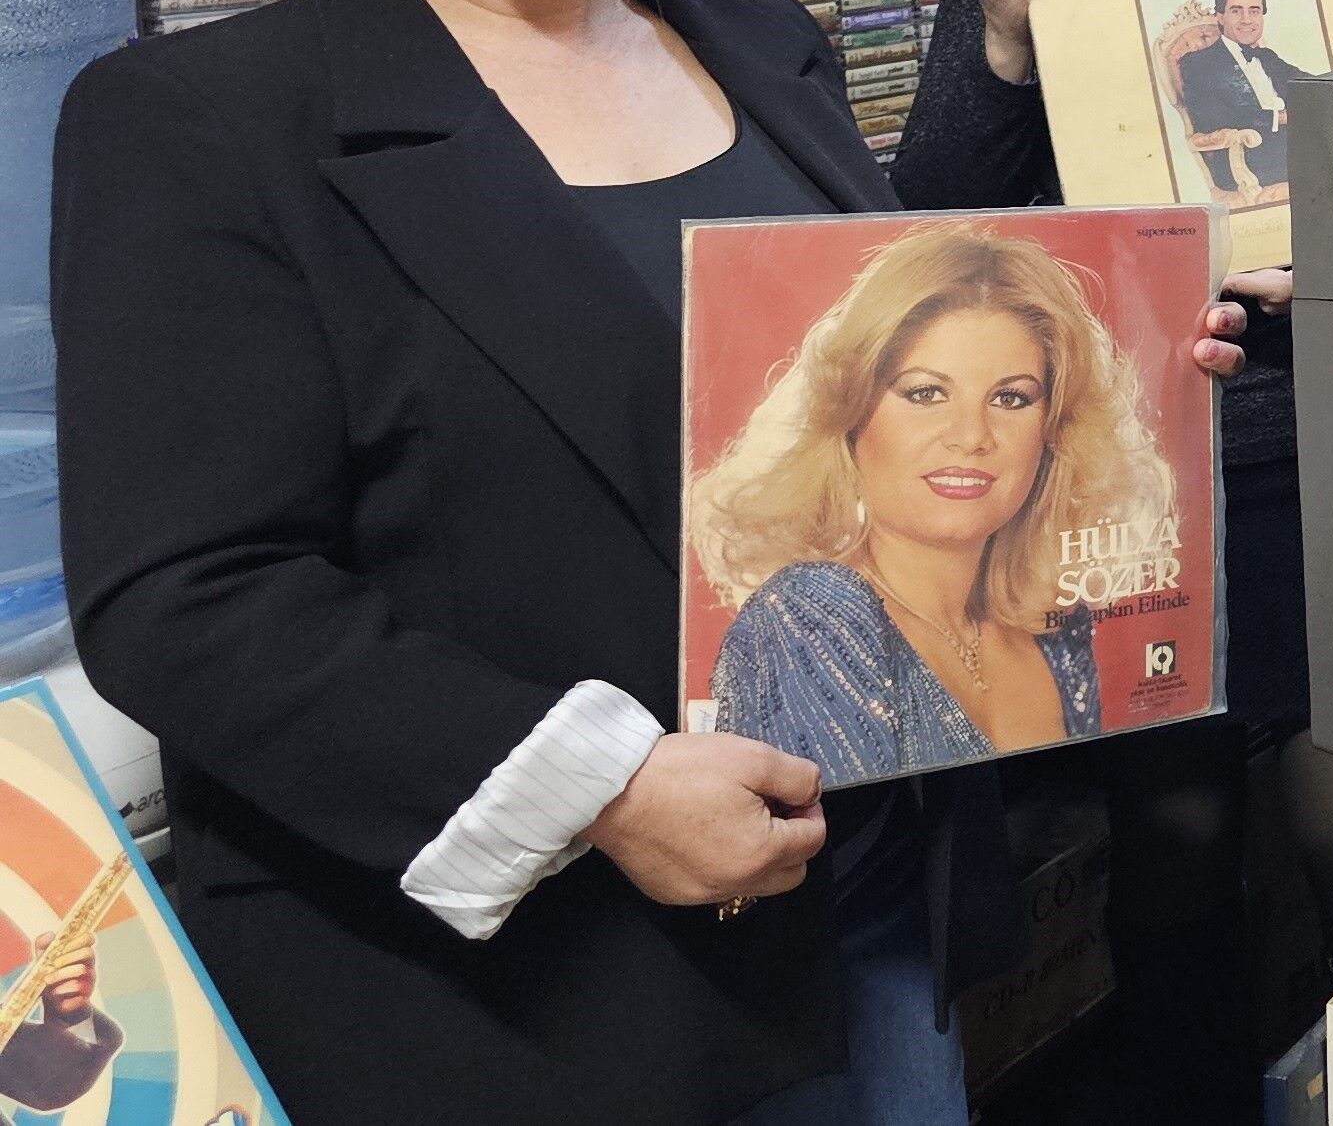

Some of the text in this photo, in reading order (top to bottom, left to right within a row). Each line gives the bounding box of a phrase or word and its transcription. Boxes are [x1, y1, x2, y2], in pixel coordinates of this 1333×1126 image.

[1059, 517, 1182, 566] HÜLYA
[1055, 557, 1182, 607] SÖZER
[1138, 591, 1190, 616] Elinde
